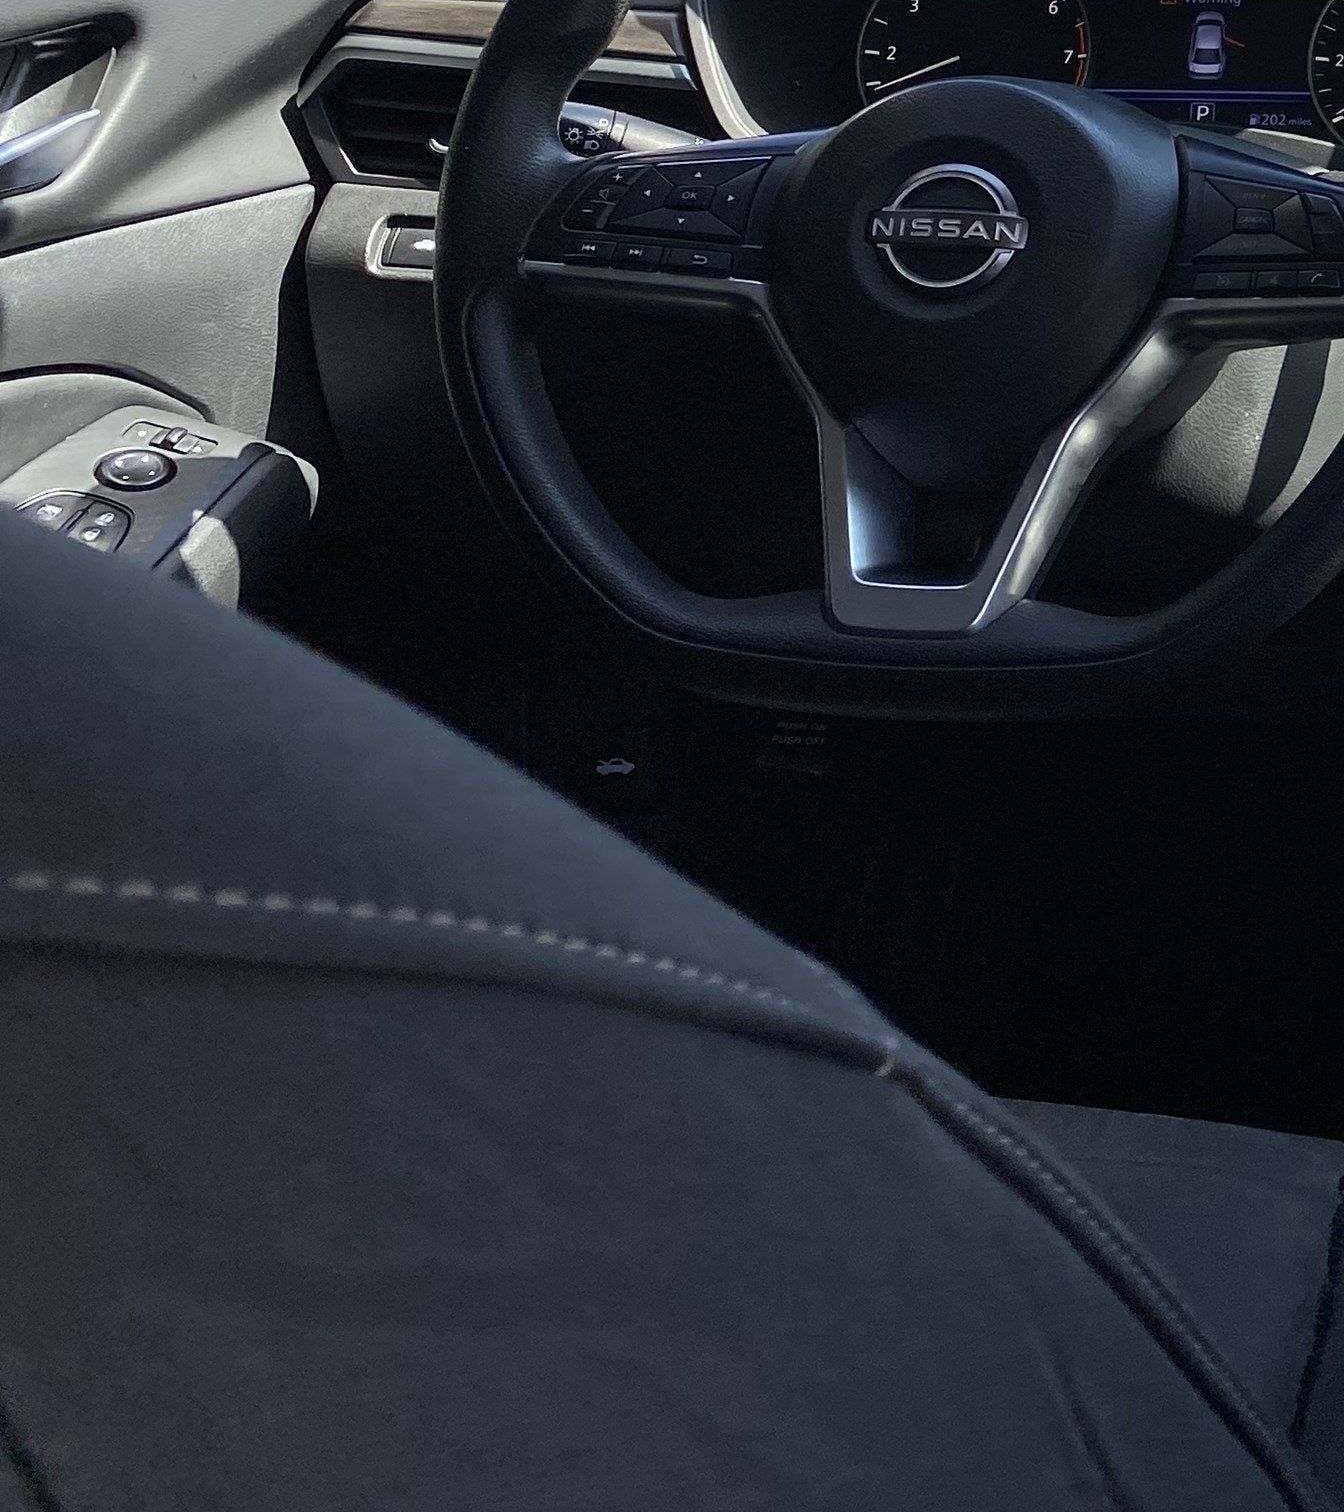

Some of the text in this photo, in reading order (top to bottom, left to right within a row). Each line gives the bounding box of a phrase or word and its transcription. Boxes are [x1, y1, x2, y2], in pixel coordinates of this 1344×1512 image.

[1048, 0, 1059, 15] 6
[886, 45, 897, 60] 2
[1063, 49, 1074, 64] 7
[1196, 105, 1210, 121] P
[1261, 114, 1313, 126] 202 miles
[681, 190, 698, 200] OK
[870, 216, 1021, 244] NISSAN
